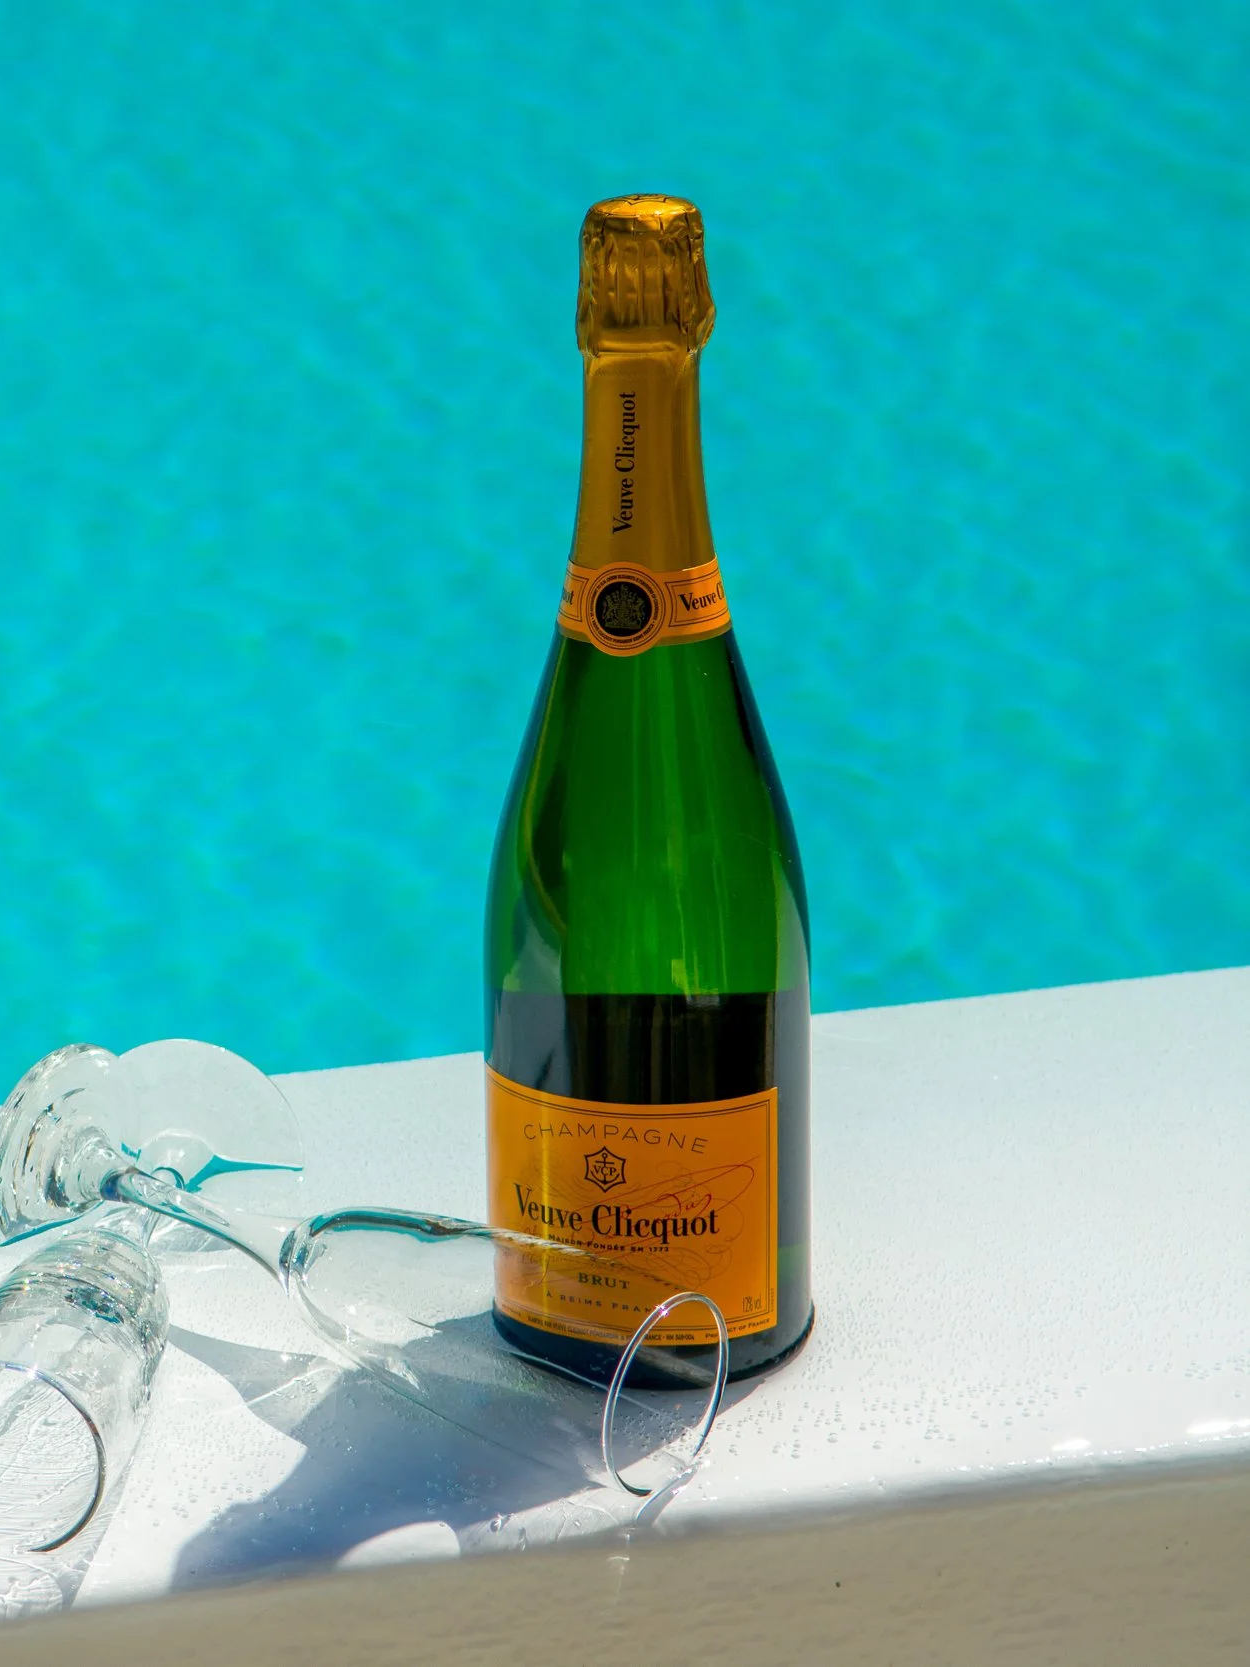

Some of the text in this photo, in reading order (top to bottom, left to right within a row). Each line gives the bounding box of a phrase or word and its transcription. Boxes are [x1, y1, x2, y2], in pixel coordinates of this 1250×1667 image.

[612, 391, 640, 535] Veuve Clicquot
[678, 592, 717, 612] Veuve
[523, 1122, 709, 1155] CHAMPAGNE
[593, 1165, 617, 1176] VCP
[513, 1182, 583, 1232] Veuve
[591, 1204, 720, 1244] Clicquot
[578, 1272, 630, 1290] BRUT
[560, 1294, 602, 1308] REIMS
[612, 1302, 653, 1314] FRAN
